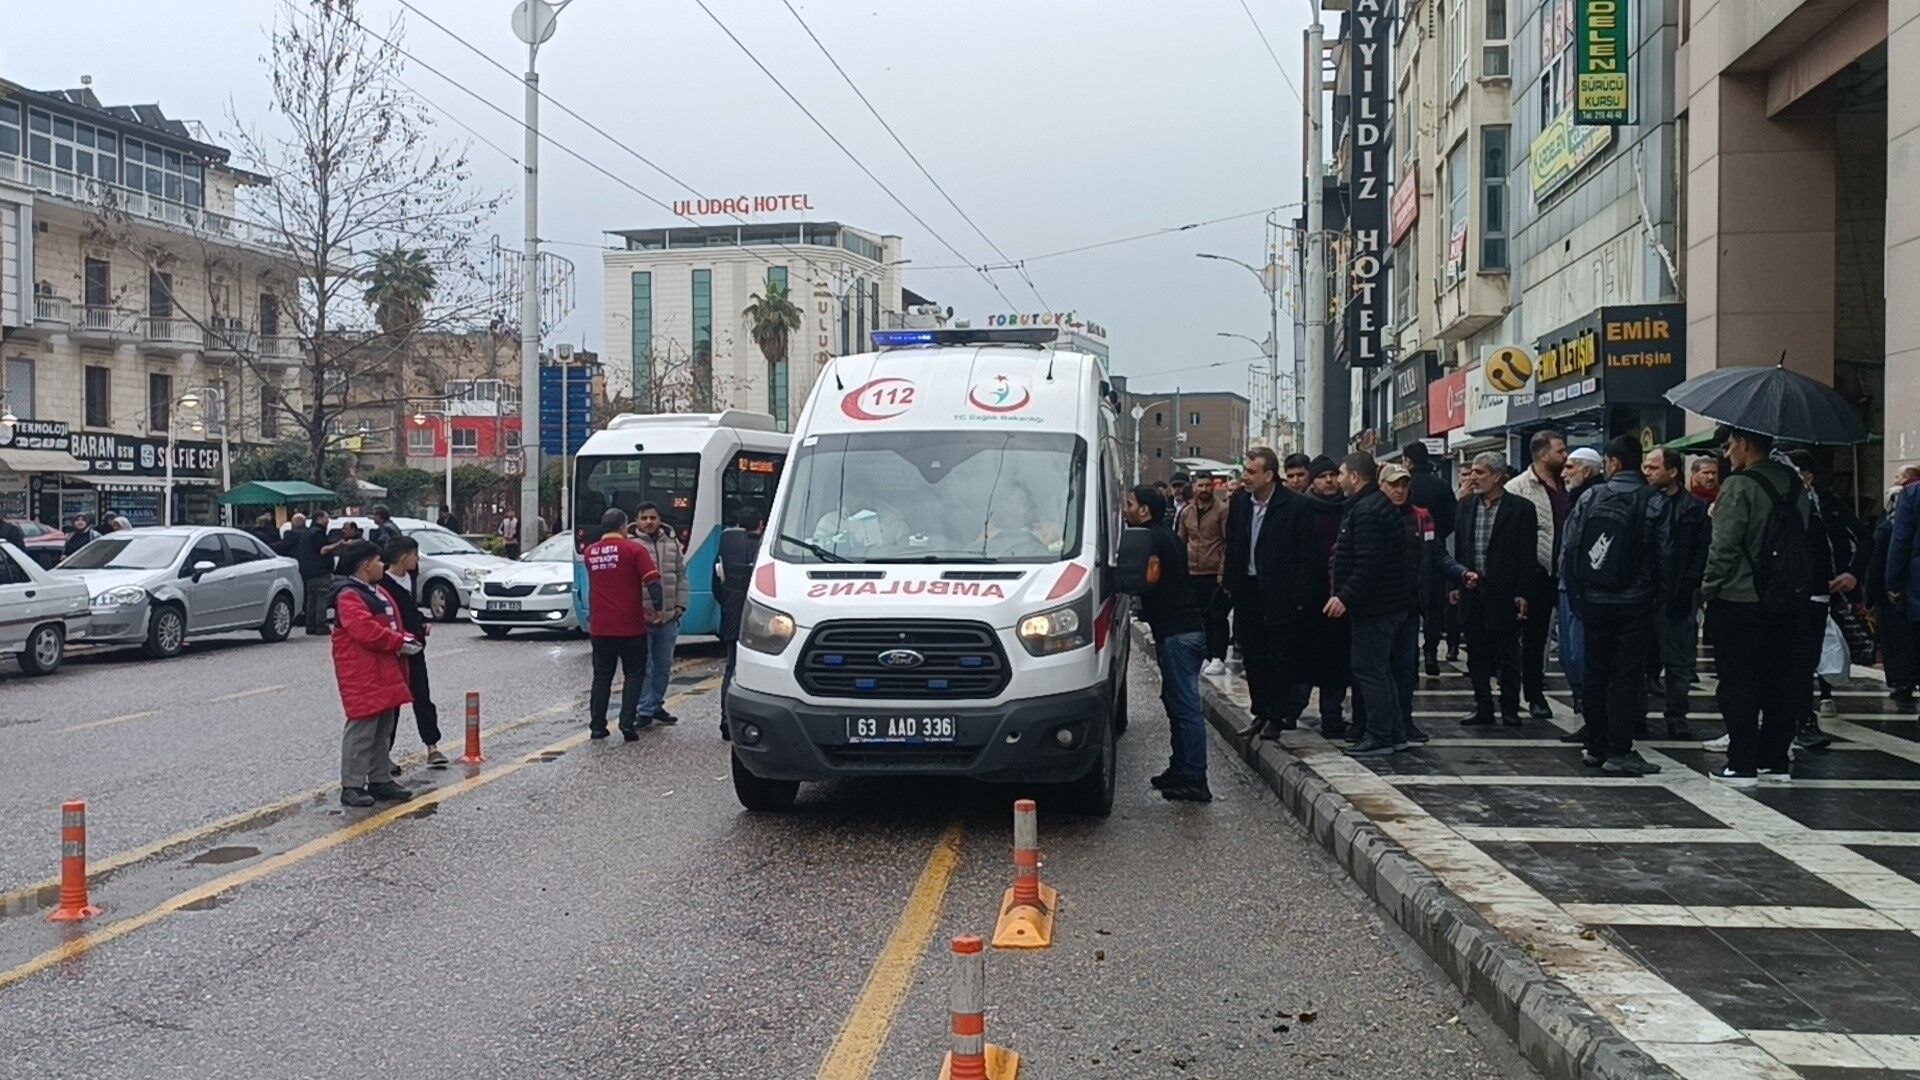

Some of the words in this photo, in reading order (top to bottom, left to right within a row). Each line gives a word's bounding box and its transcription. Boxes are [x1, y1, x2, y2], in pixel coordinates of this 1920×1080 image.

[1581, 76, 1624, 91] SÜRÜCÜ
[1585, 95, 1620, 107] KURSU
[673, 195, 749, 216] ULUDAĞ
[754, 194, 814, 212] HOTEL
[1354, 229, 1380, 358] HOTEL
[1606, 317, 1670, 341] EMİR
[1607, 351, 1672, 367] İLETİŞİM
[872, 387, 915, 406] 112
[71, 434, 115, 458] BARAN
[198, 449, 219, 470] CEP
[887, 653, 914, 665] Ford
[858, 718, 876, 736] 63
[888, 718, 916, 736] AAD
[922, 718, 951, 736] 336
